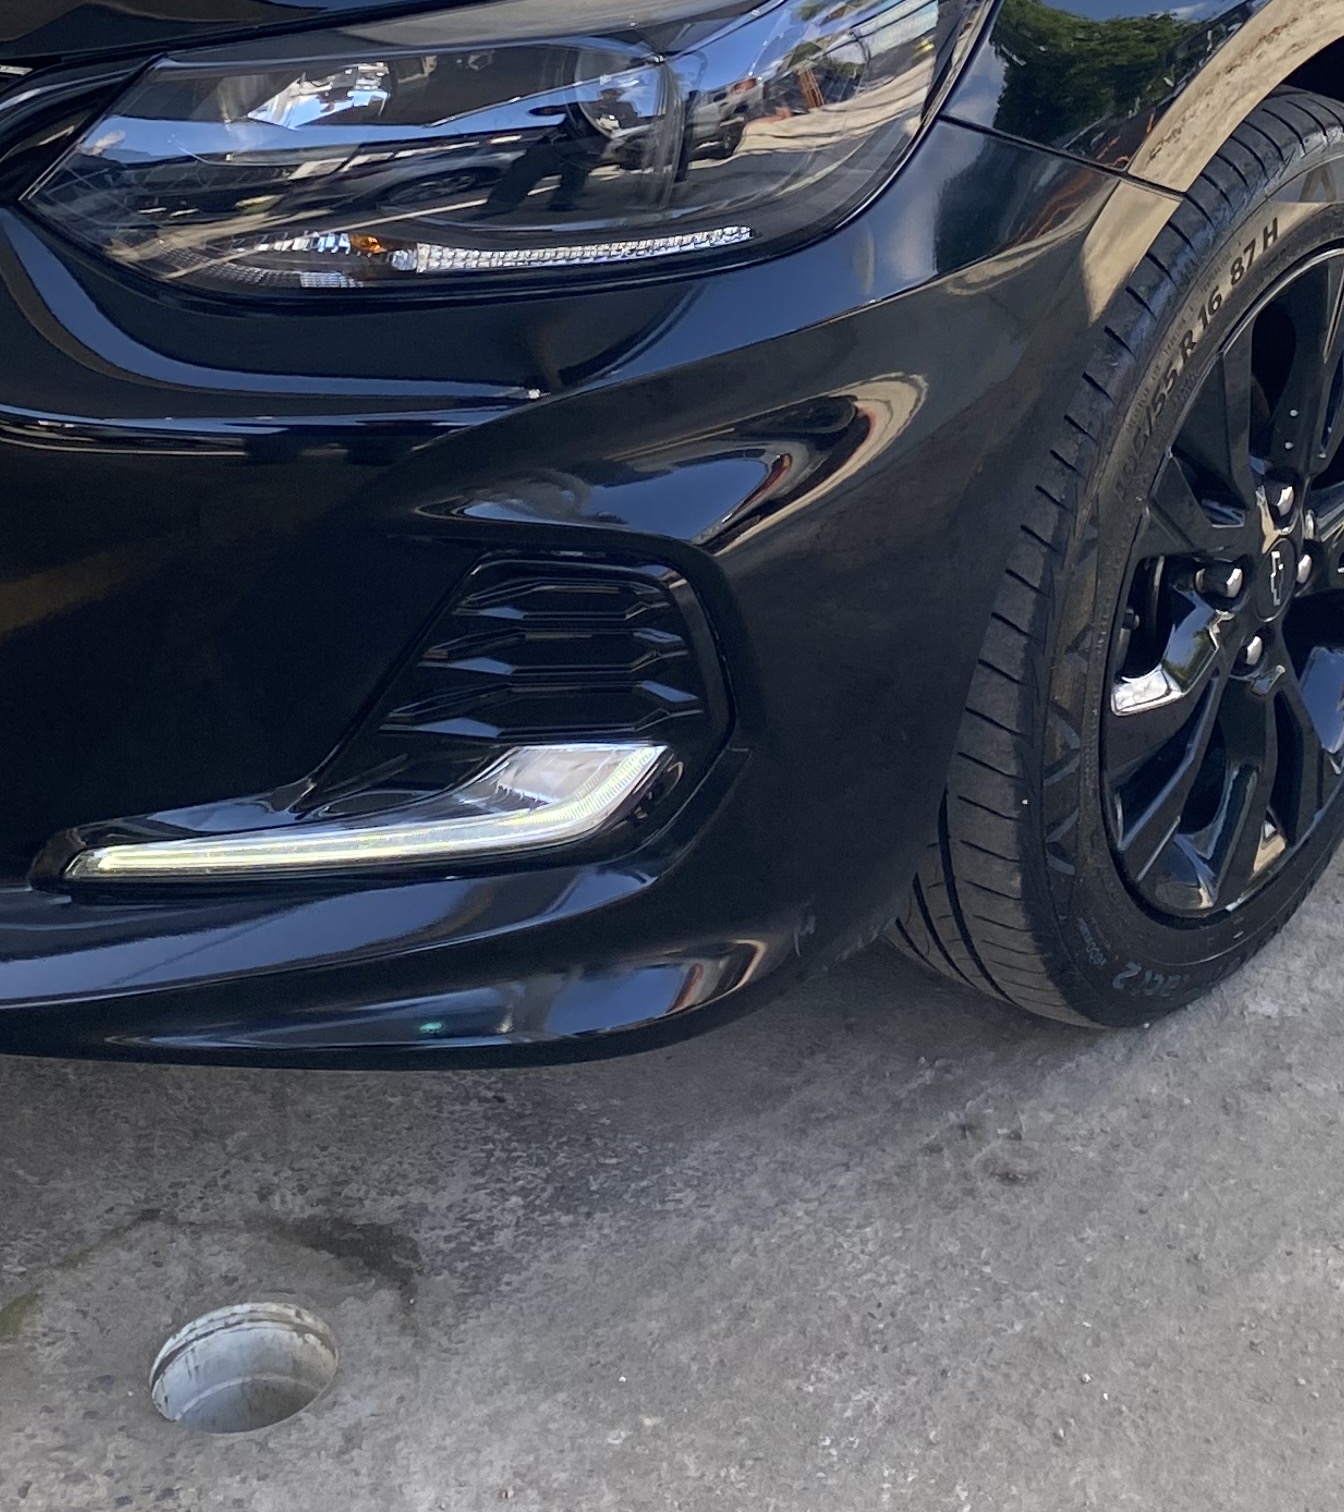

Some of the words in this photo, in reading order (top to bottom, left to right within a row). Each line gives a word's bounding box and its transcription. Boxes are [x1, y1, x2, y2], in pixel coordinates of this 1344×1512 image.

[1197, 285, 1222, 330] 16
[1230, 237, 1255, 286] 87
[1263, 217, 1278, 253] H
